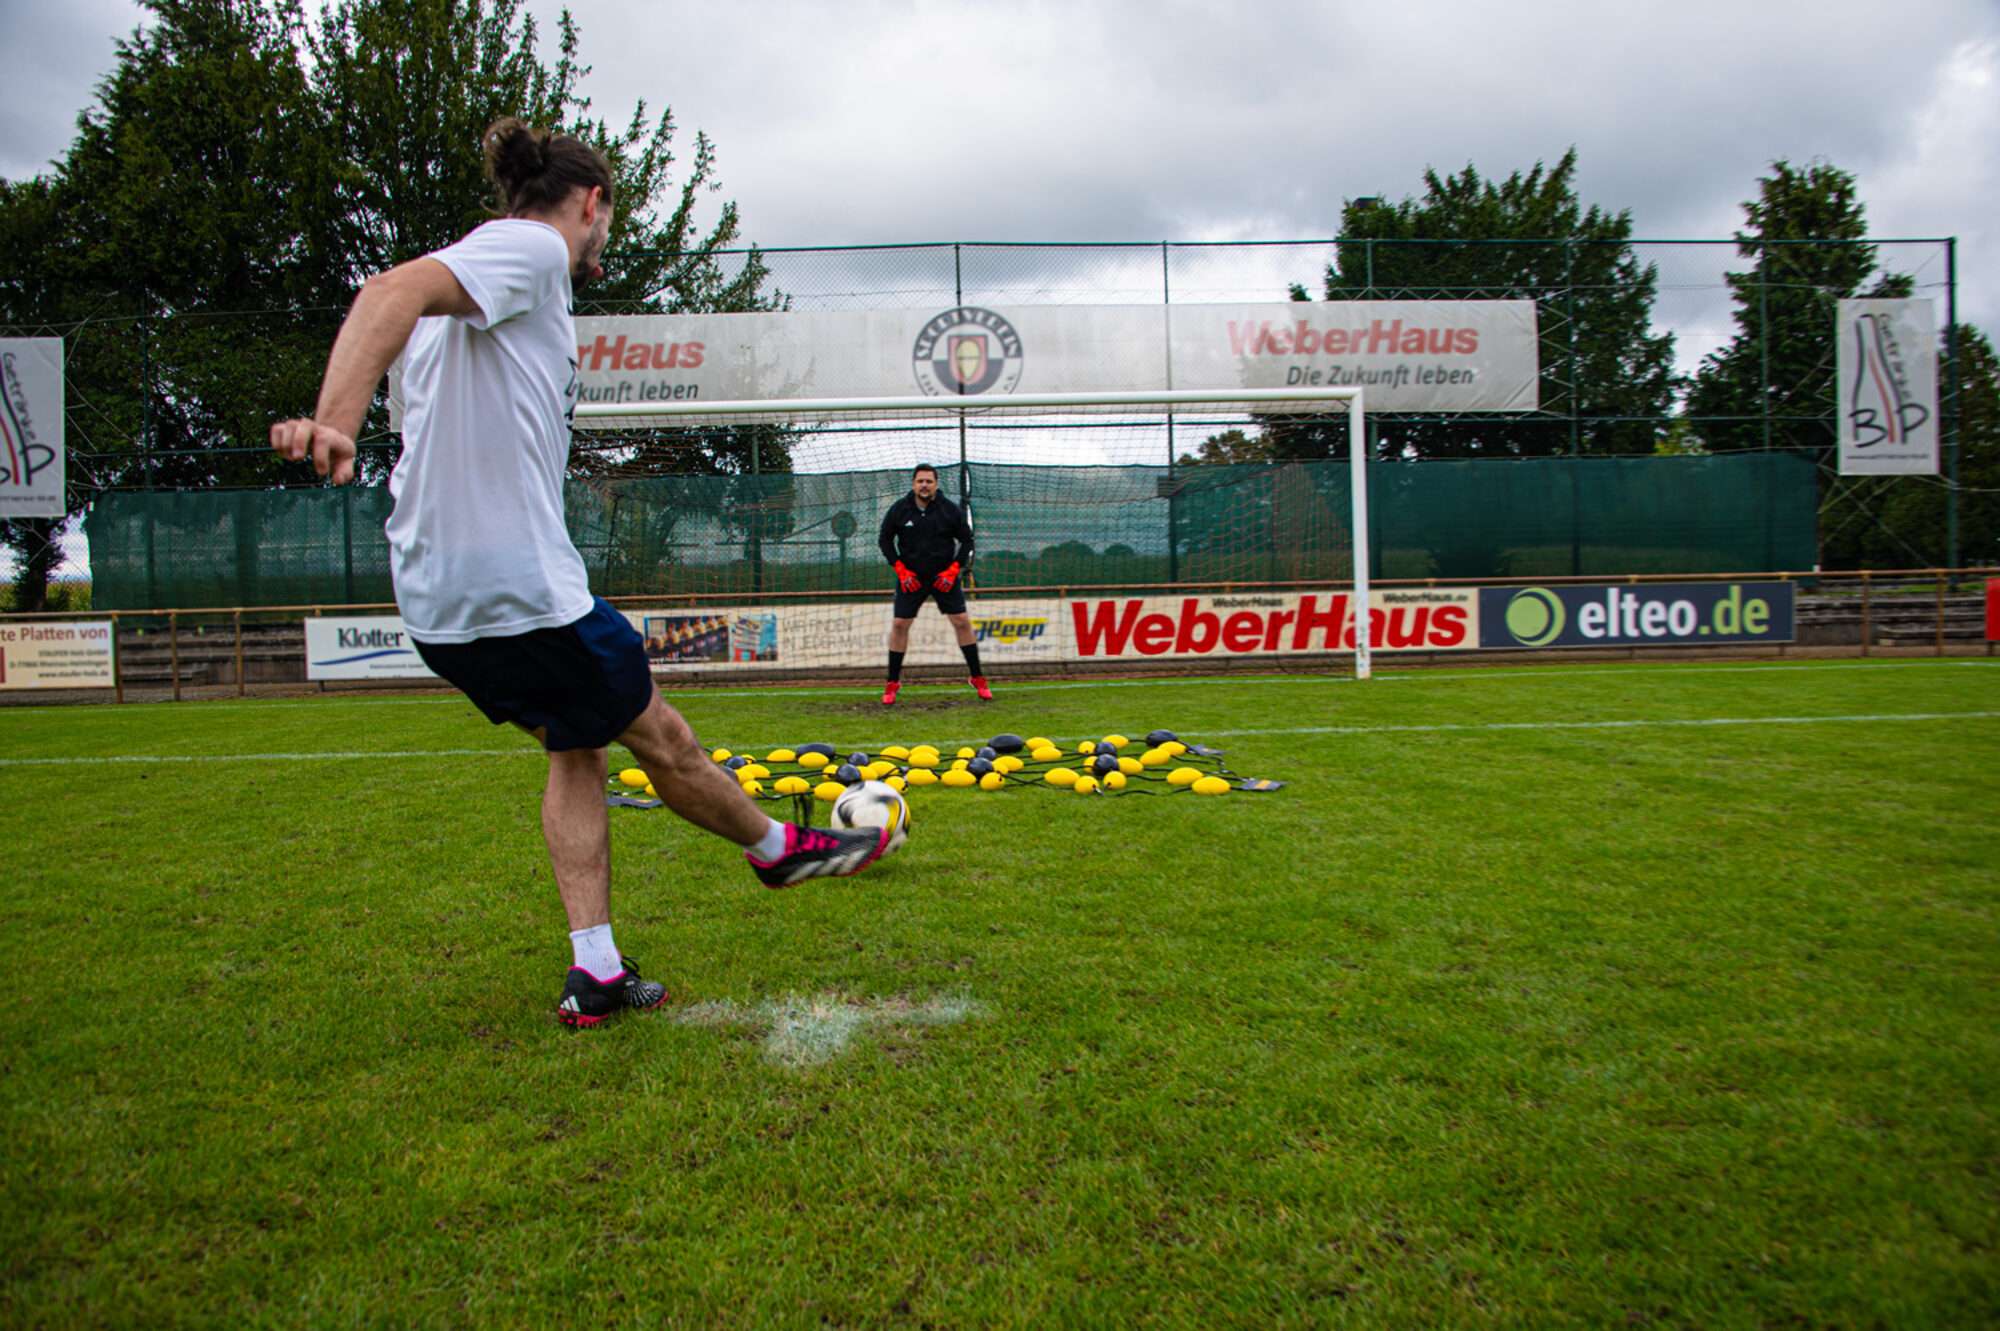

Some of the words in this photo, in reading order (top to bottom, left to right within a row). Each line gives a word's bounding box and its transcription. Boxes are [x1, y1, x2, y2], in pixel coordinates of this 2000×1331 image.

[1227, 319, 1479, 356] WeberHaus
[1286, 366, 1322, 386] Die
[1327, 365, 1411, 389] Zukunft
[1415, 365, 1474, 385] leben
[640, 380, 699, 400] leben
[1578, 585, 1770, 638] elteo.de
[21, 627, 75, 640] Platten
[80, 628, 108, 639] von
[1071, 594, 1469, 656] WeberHaus
[338, 627, 404, 649] Klotter
